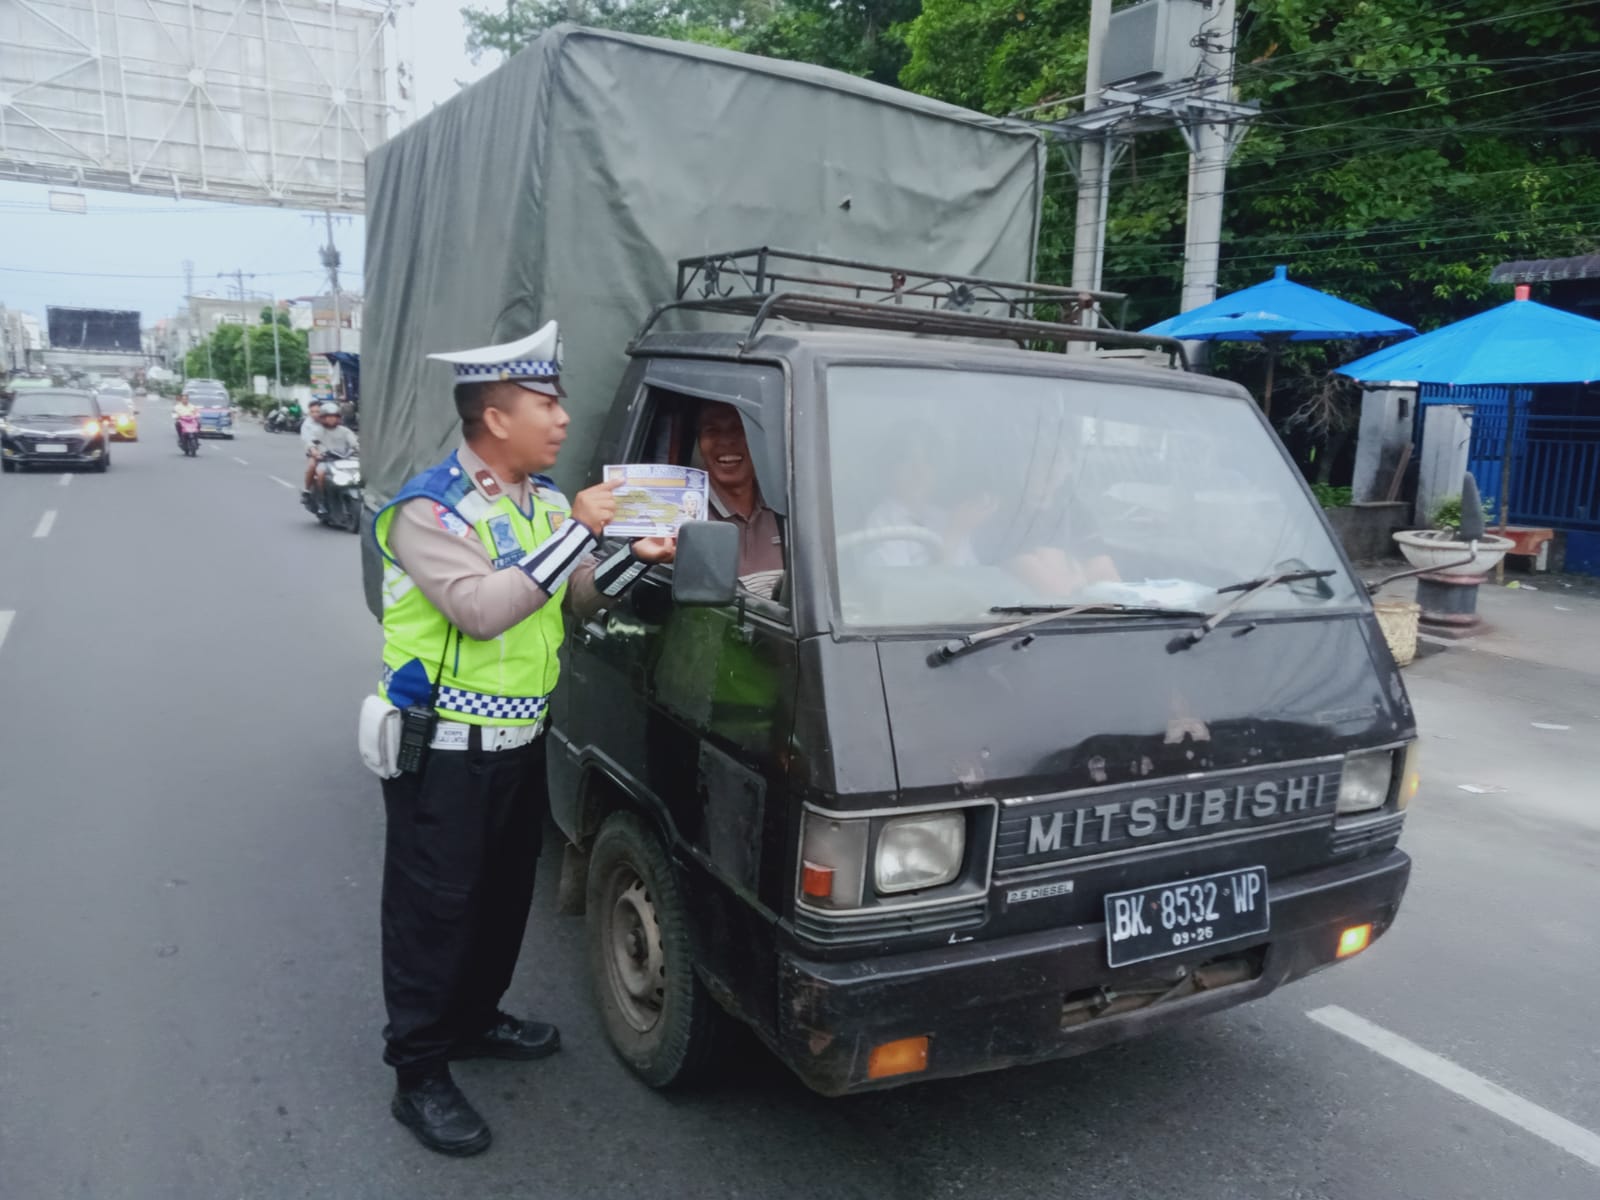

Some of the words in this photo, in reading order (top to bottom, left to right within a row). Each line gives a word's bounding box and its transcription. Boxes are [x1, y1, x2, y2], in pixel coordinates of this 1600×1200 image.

[1027, 774, 1326, 855] MITSUBISHI
[1031, 884, 1071, 898] DIESEL
[1160, 881, 1220, 930] 8532
[1231, 872, 1261, 914] WP
